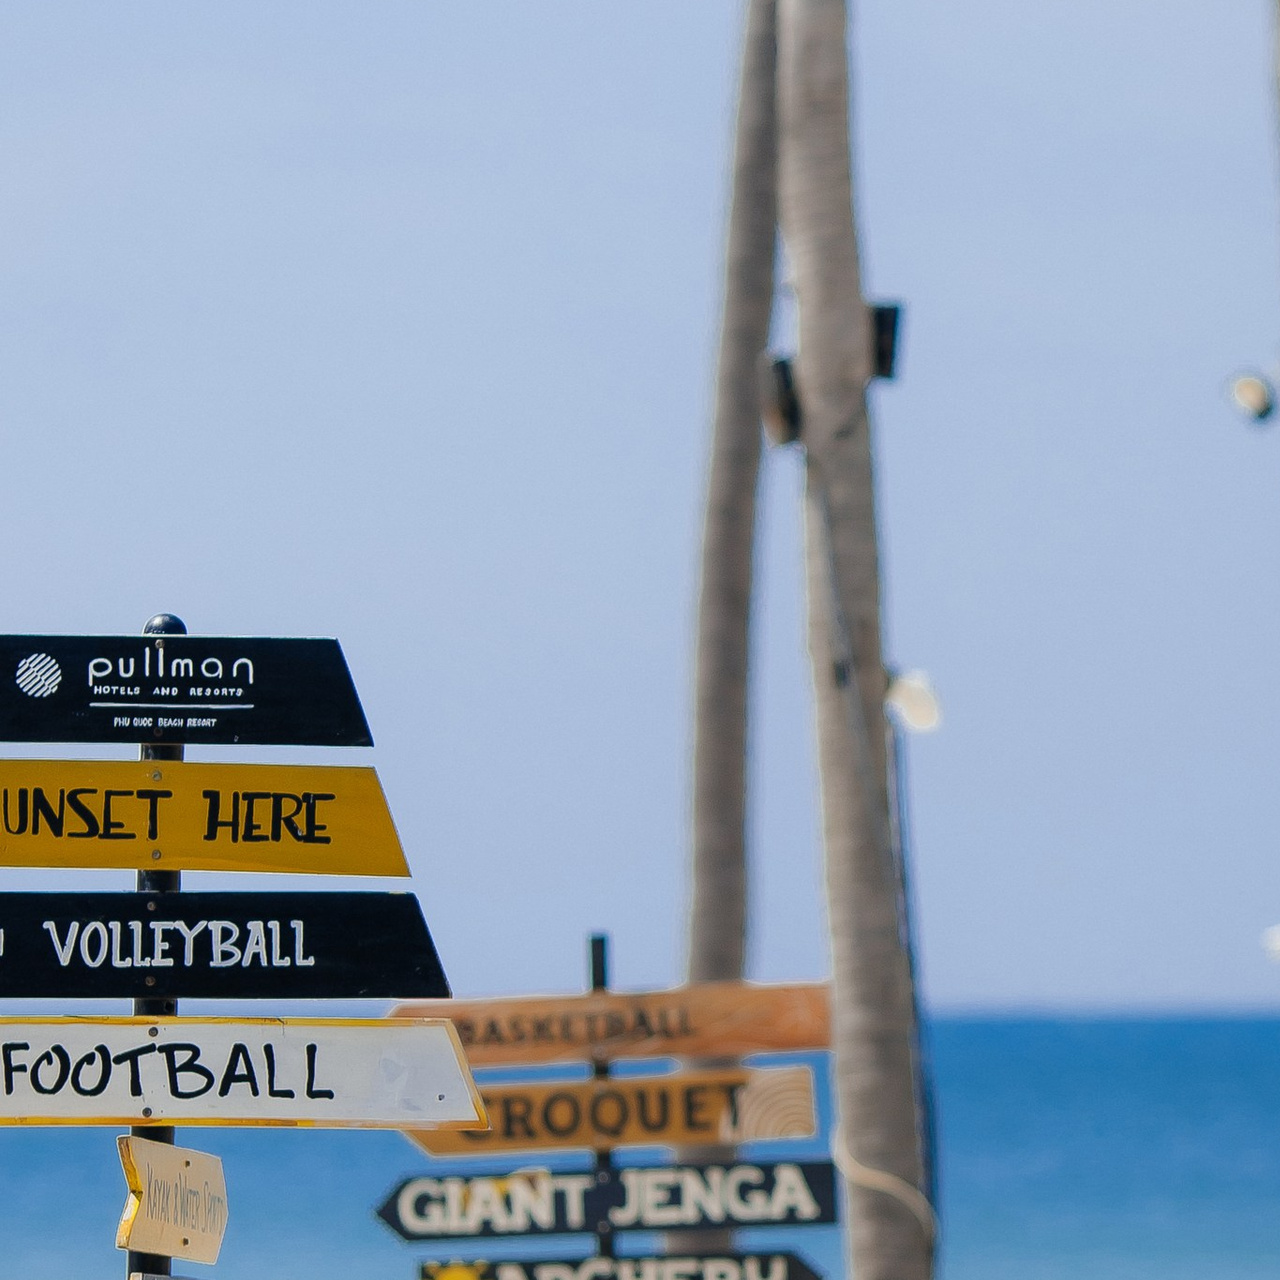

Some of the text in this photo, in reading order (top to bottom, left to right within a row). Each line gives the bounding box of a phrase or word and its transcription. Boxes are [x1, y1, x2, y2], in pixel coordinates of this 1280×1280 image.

[88, 646, 254, 687] pullman
[93, 685, 244, 697] HOTELS AND RESORTS
[113, 717, 130, 727] PHU
[158, 717, 183, 727] BEACH
[187, 718, 217, 727] RESORT
[203, 790, 336, 844] HERE
[43, 920, 315, 967] VOLLEYBALL
[2, 1043, 335, 1099] FOOTBALL
[397, 1164, 820, 1237] GIANT JENGA
